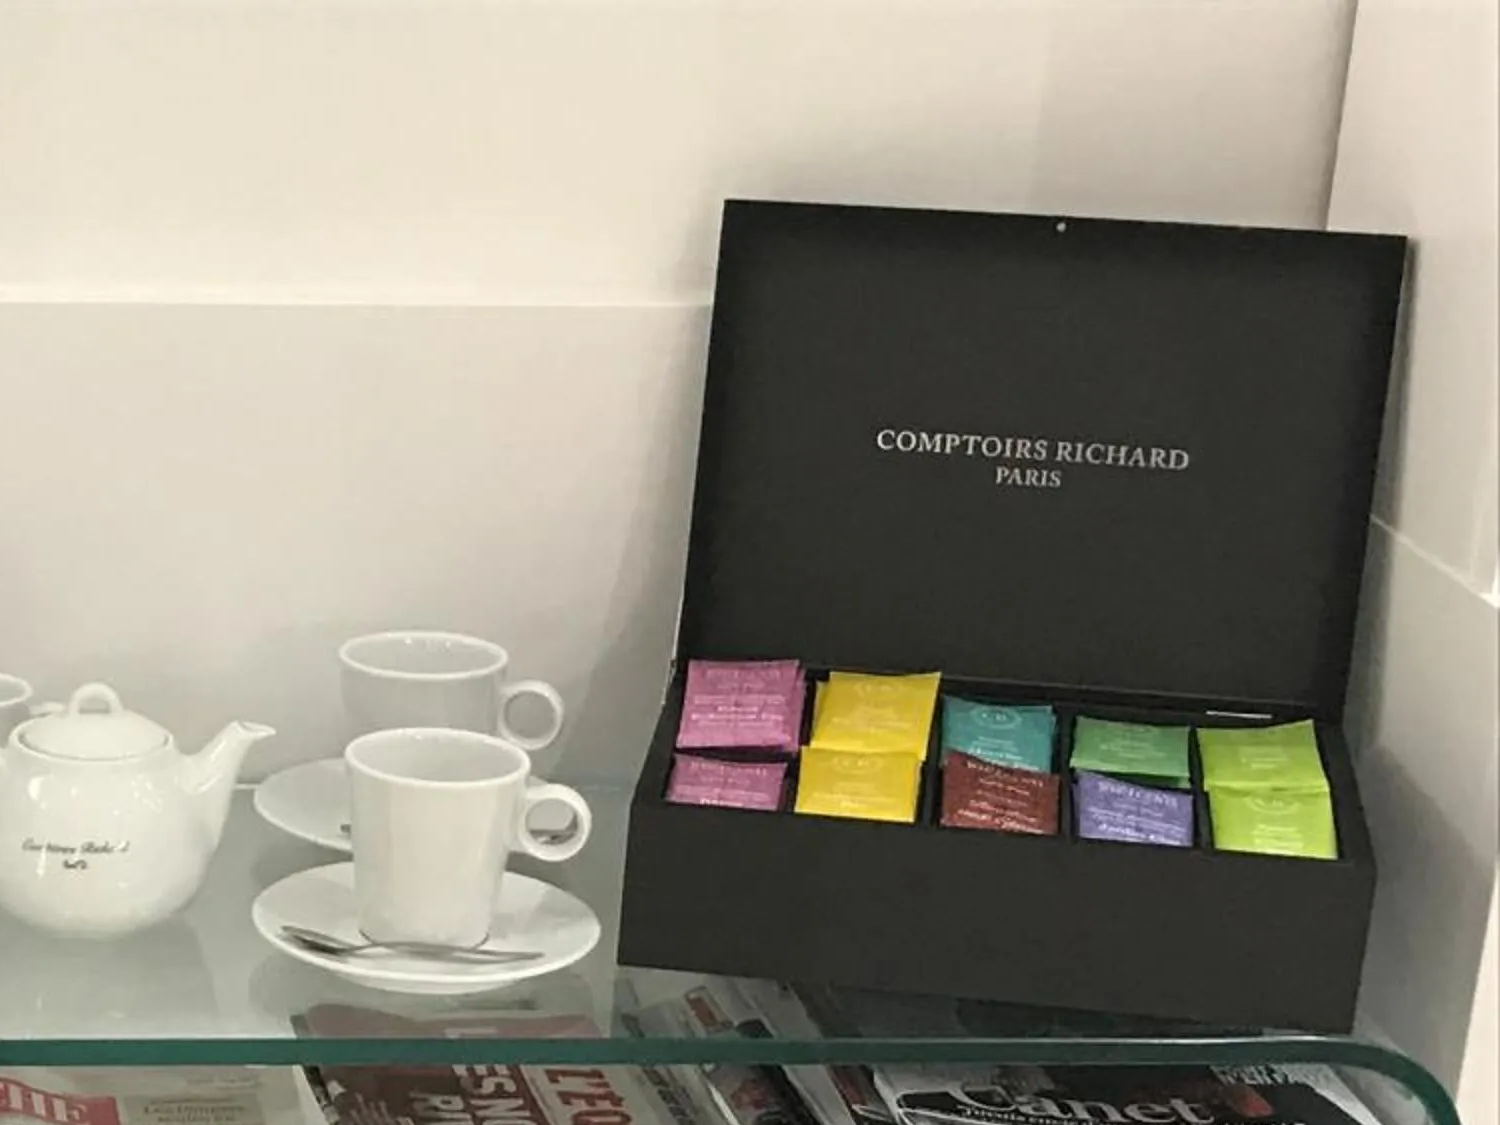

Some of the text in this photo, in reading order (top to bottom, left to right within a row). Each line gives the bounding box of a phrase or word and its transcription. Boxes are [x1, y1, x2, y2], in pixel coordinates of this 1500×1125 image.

[876, 428, 1191, 471] COMPTOIRS RICHARD
[995, 466, 1063, 489] PARIS
[947, 1079, 1216, 1125] Canet
